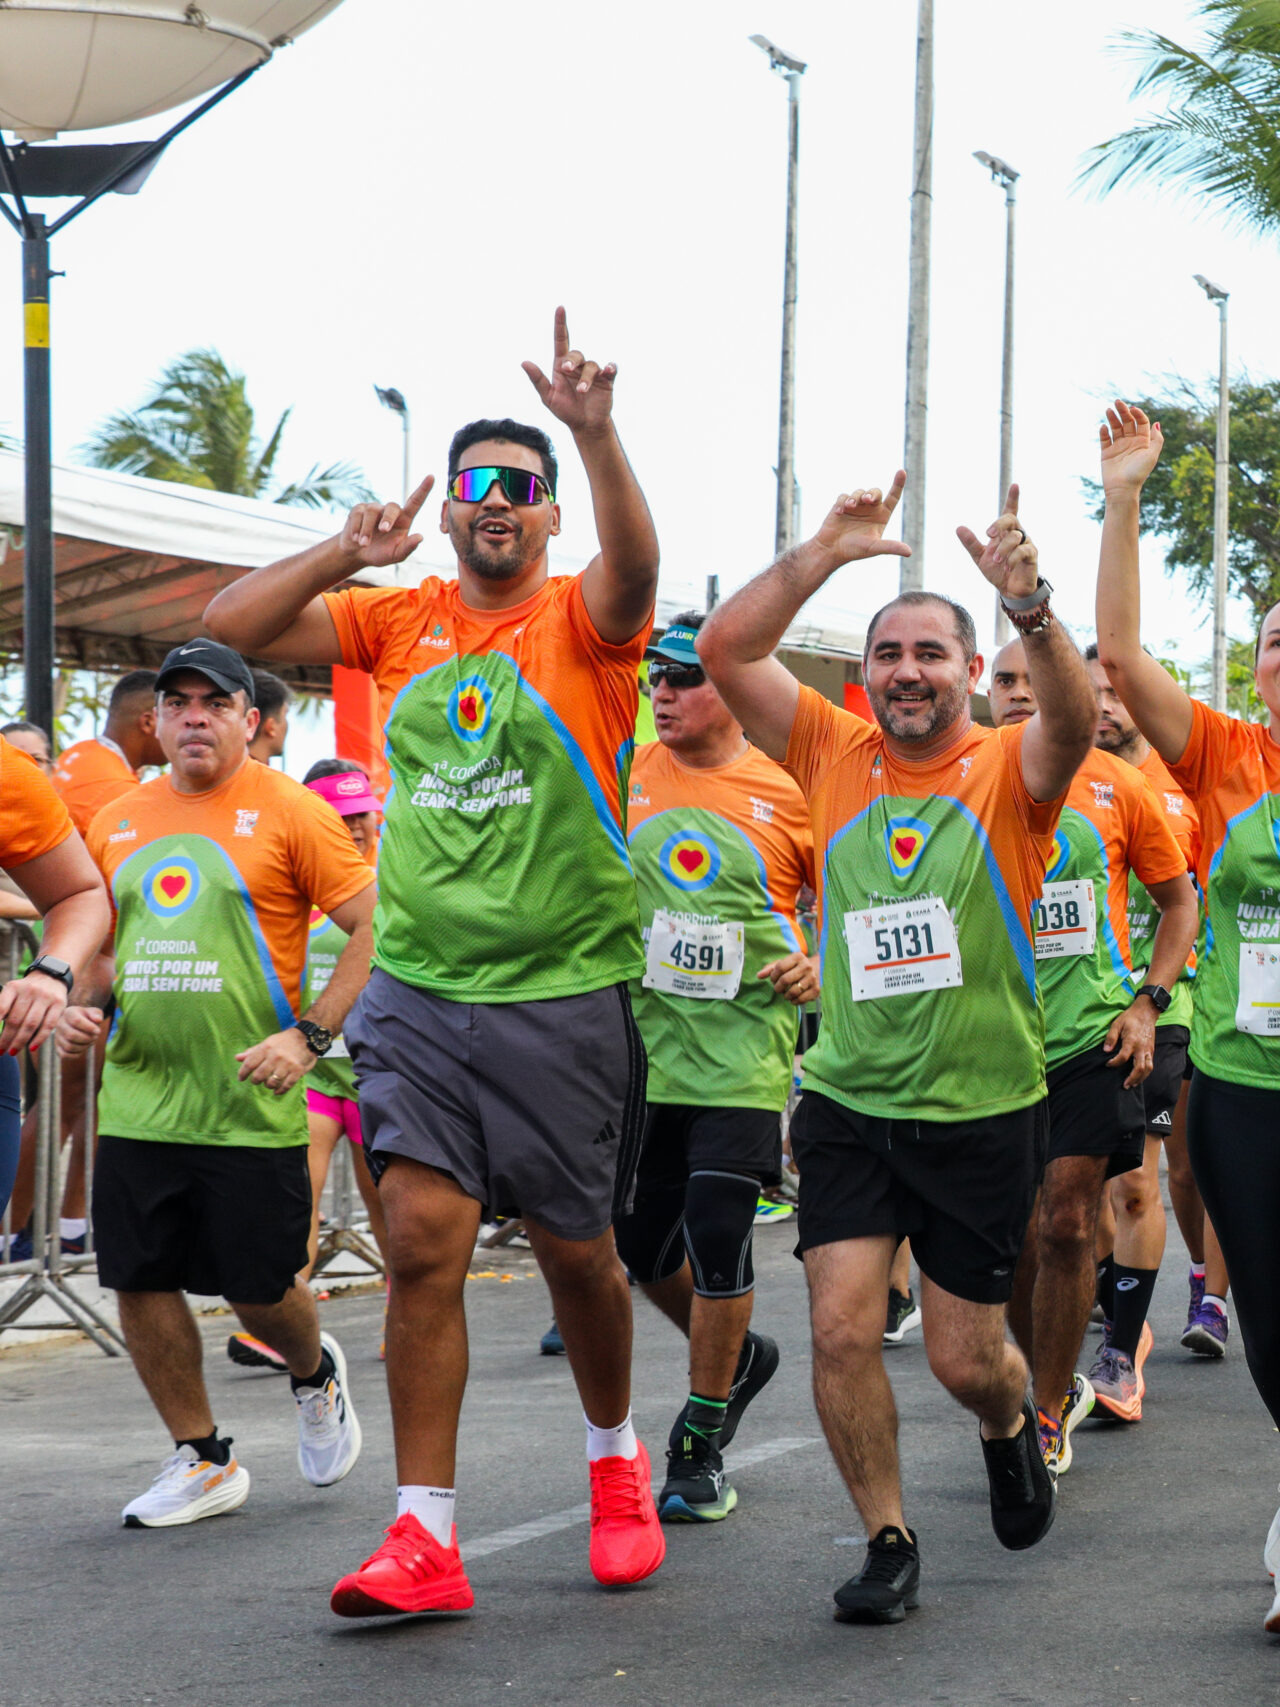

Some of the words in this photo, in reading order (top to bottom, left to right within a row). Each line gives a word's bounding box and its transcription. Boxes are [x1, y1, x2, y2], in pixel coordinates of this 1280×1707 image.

[411, 790, 457, 809] CEARÁ
[1260, 887, 1274, 900] 1ª
[1037, 900, 1081, 931] 038
[1237, 919, 1280, 938] EARÁ
[135, 937, 146, 955] 1ª
[146, 940, 198, 955] CORRIDA
[874, 922, 935, 961] 5131
[670, 939, 724, 971] 4591
[161, 961, 191, 976] POR
[194, 961, 219, 975] UM
[152, 977, 179, 992] SEM
[181, 978, 223, 993] FOME
